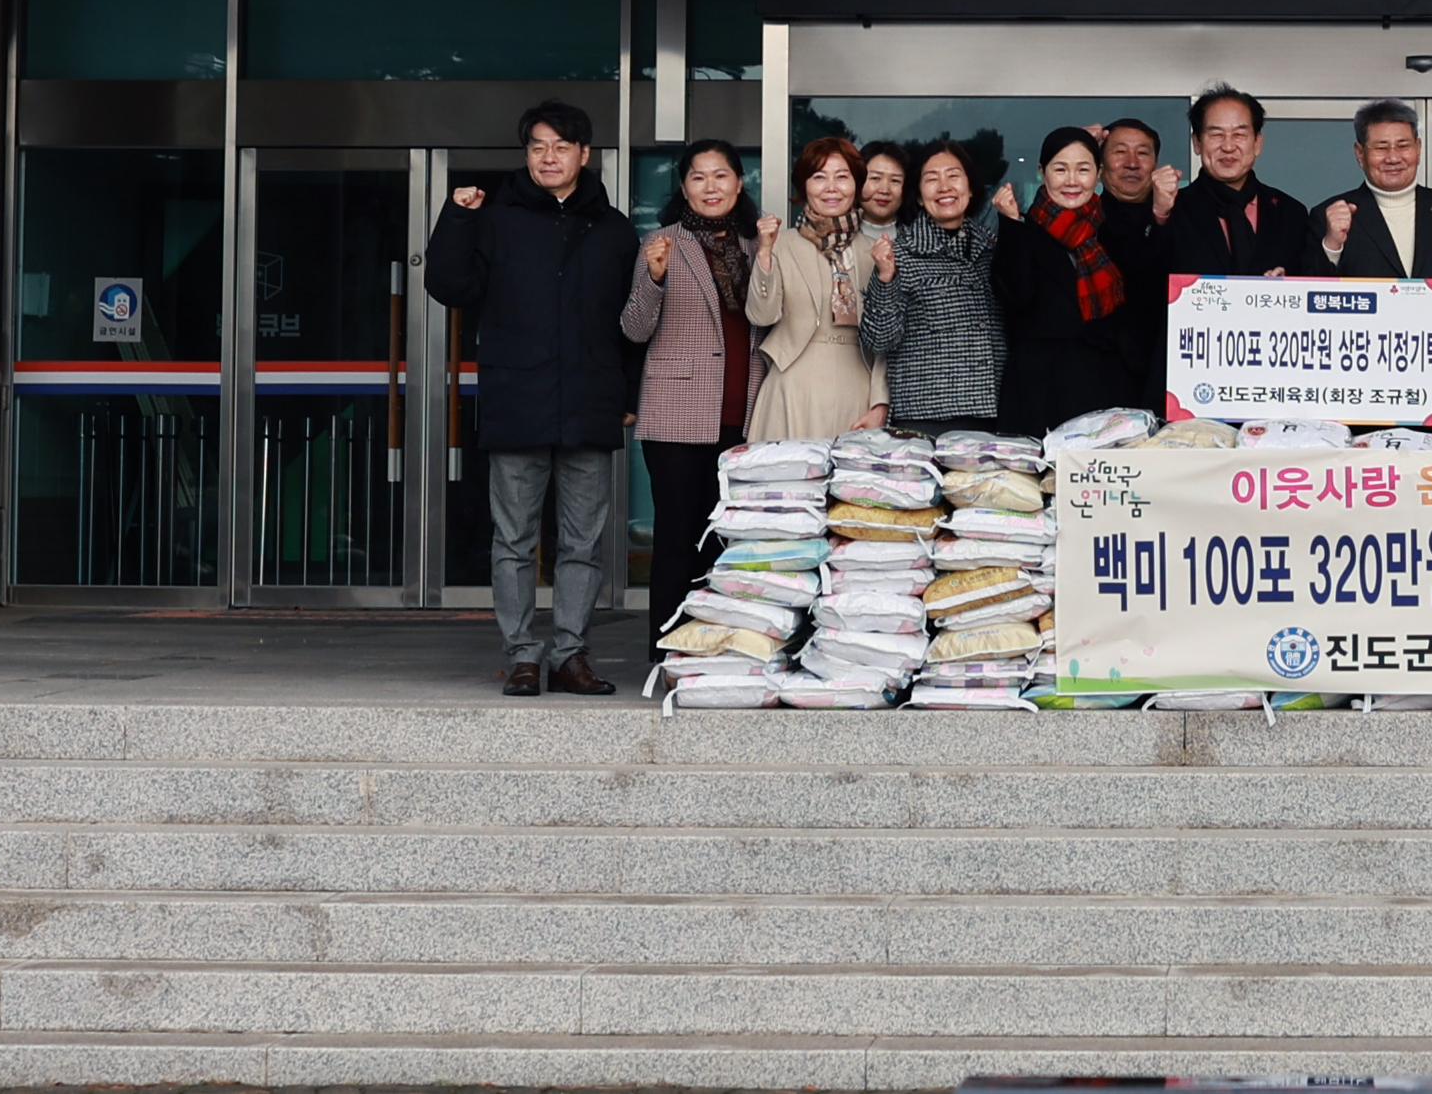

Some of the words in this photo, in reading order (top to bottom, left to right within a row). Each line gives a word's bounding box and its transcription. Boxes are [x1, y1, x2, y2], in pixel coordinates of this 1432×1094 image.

[1245, 294, 1303, 309] 이웃사랑
[1313, 294, 1371, 311] 행복나눔
[99, 326, 136, 336] 금연시설
[1179, 327, 1211, 369] 백미
[1217, 330, 1263, 368] 100포
[1268, 328, 1332, 371] 320만원
[1339, 330, 1371, 372] 상당
[1217, 386, 1364, 405] 진도군체육회(회장
[1369, 388, 1428, 406] 조규철)
[1070, 458, 1142, 488] 대한민국
[1231, 465, 1402, 511] 이웃사랑
[1070, 490, 1151, 519] 온기나눔
[1093, 531, 1168, 613] 백미
[1183, 534, 1295, 606] 100포
